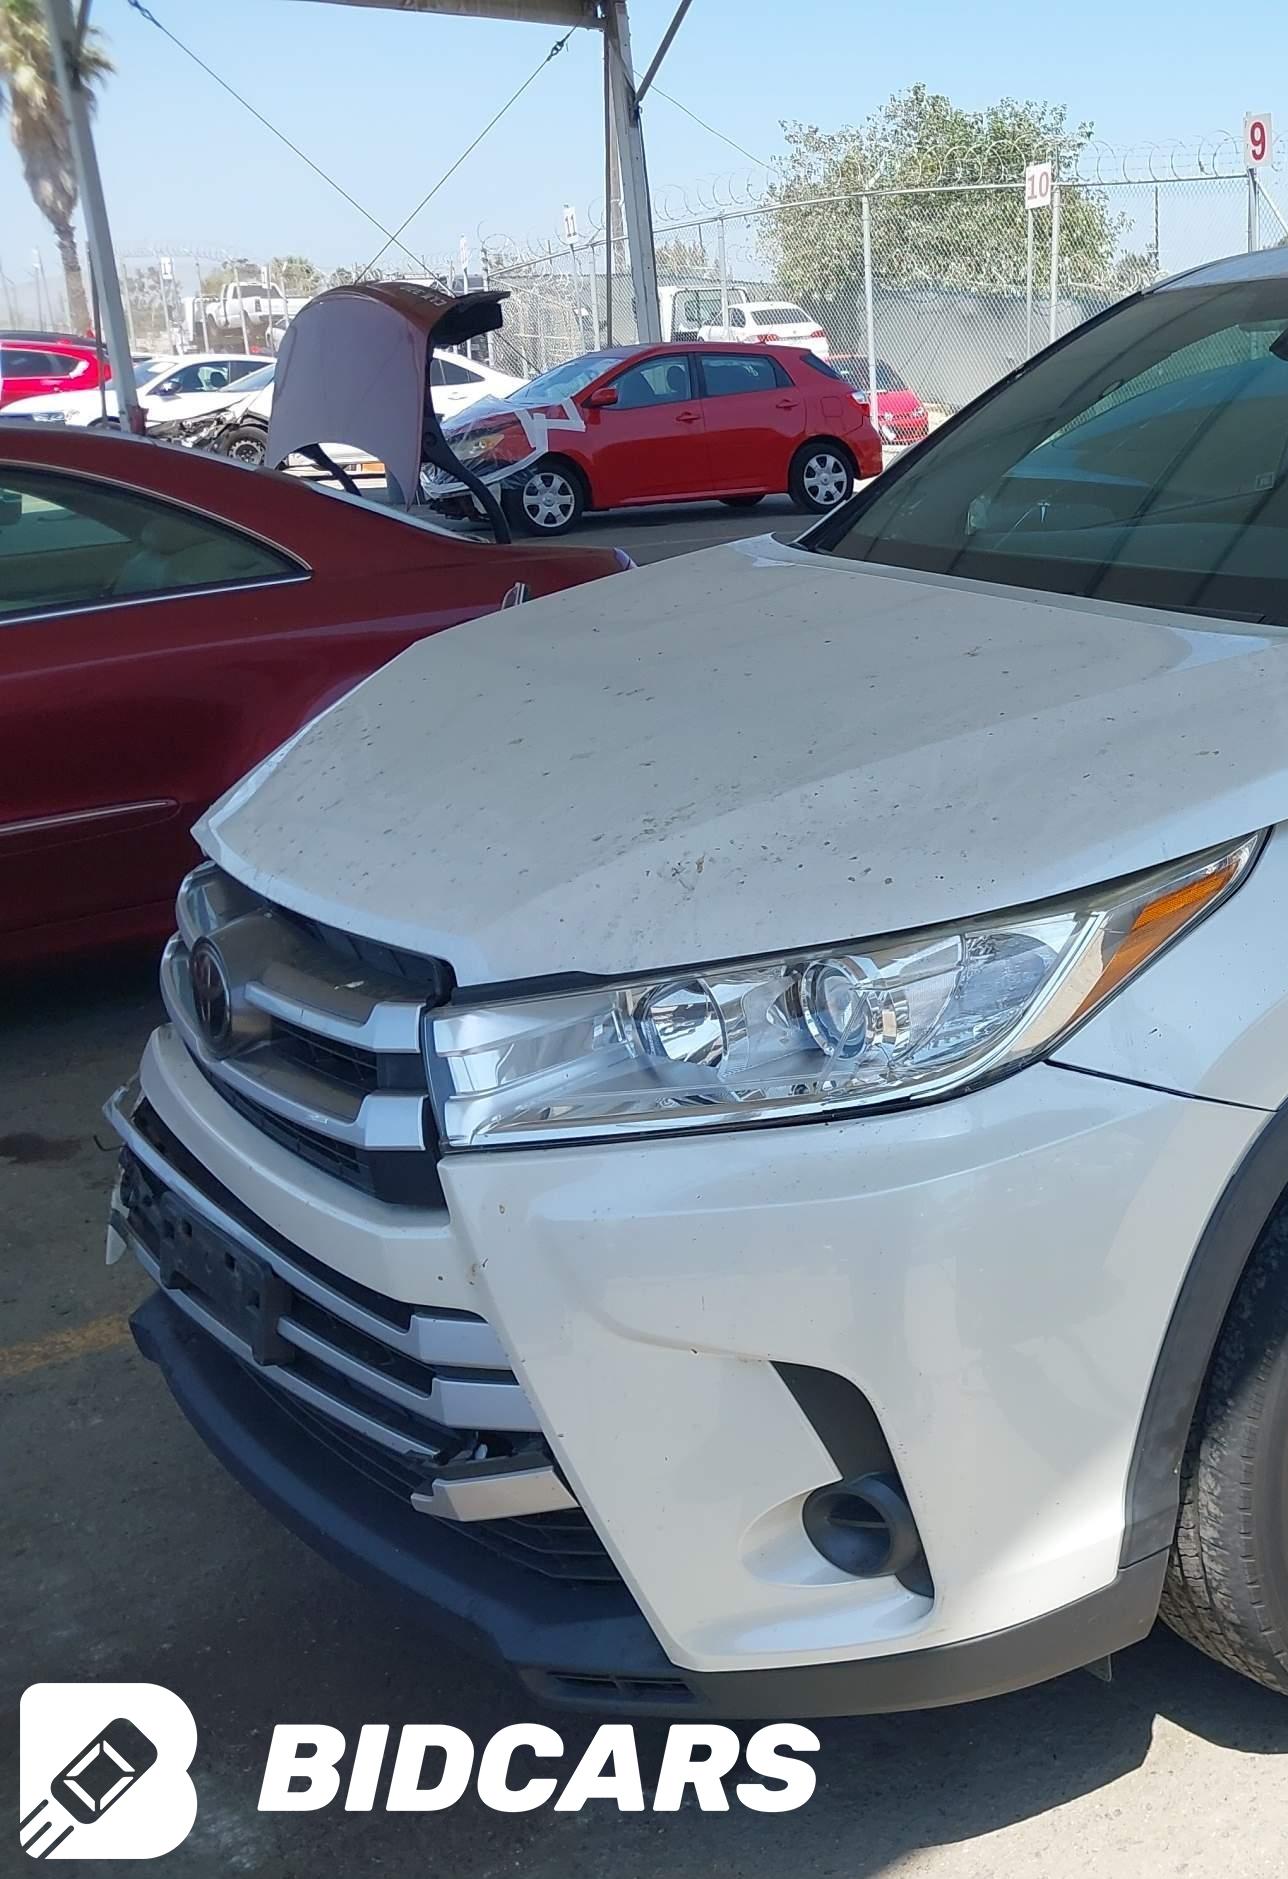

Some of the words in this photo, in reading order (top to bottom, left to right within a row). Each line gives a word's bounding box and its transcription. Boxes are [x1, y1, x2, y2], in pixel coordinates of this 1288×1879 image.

[1250, 121, 1265, 161] 9
[1027, 171, 1050, 200] 10
[564, 214, 577, 238] 11
